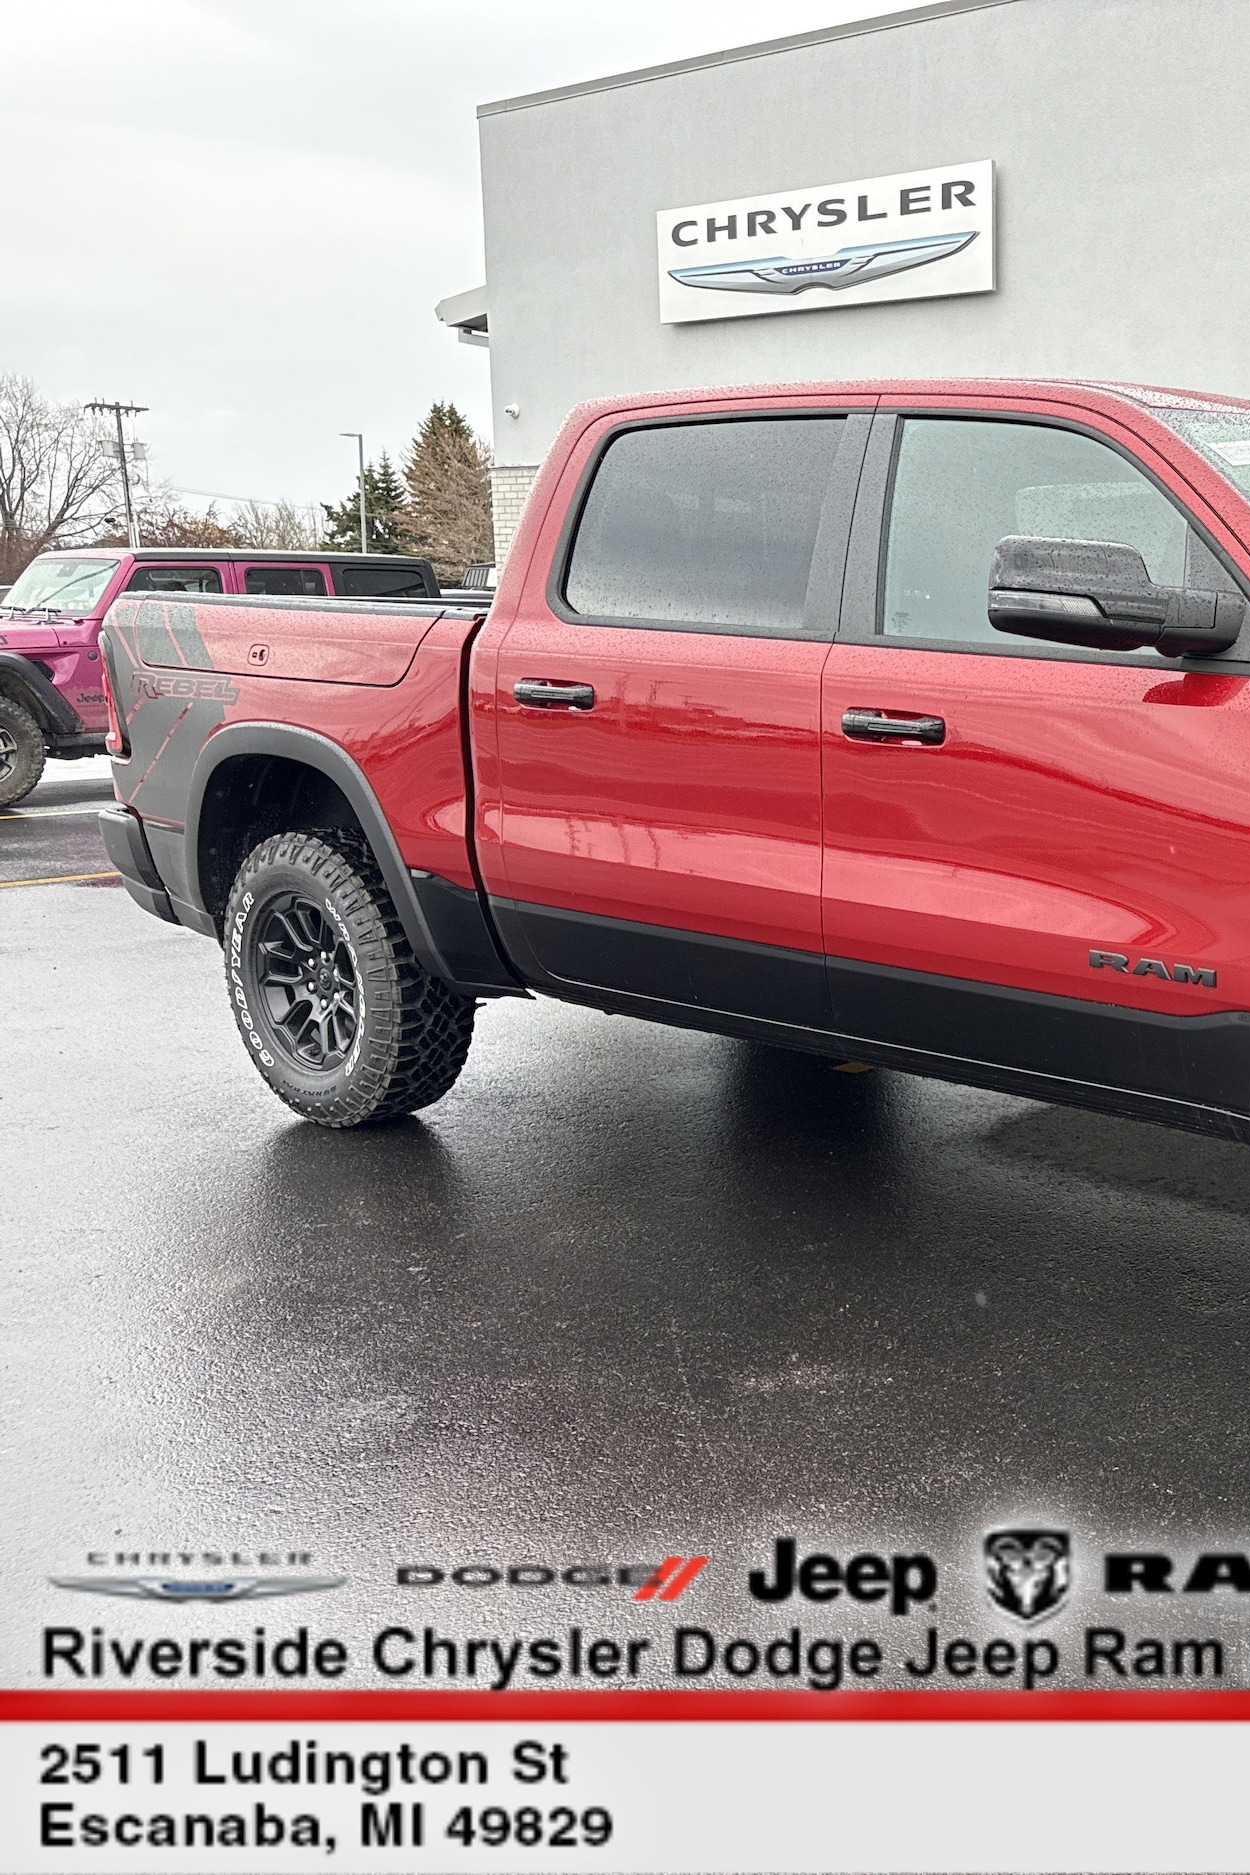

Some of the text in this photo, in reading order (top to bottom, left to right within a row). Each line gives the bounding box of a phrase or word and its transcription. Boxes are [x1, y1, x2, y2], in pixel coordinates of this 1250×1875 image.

[671, 180, 977, 247] CHRYSLER
[781, 260, 842, 275] CHRYSLER
[131, 671, 240, 705] REBEL
[231, 892, 274, 1067] GOODYEAR
[325, 898, 366, 1076] WRANGLER
[1088, 949, 1217, 988] RAM
